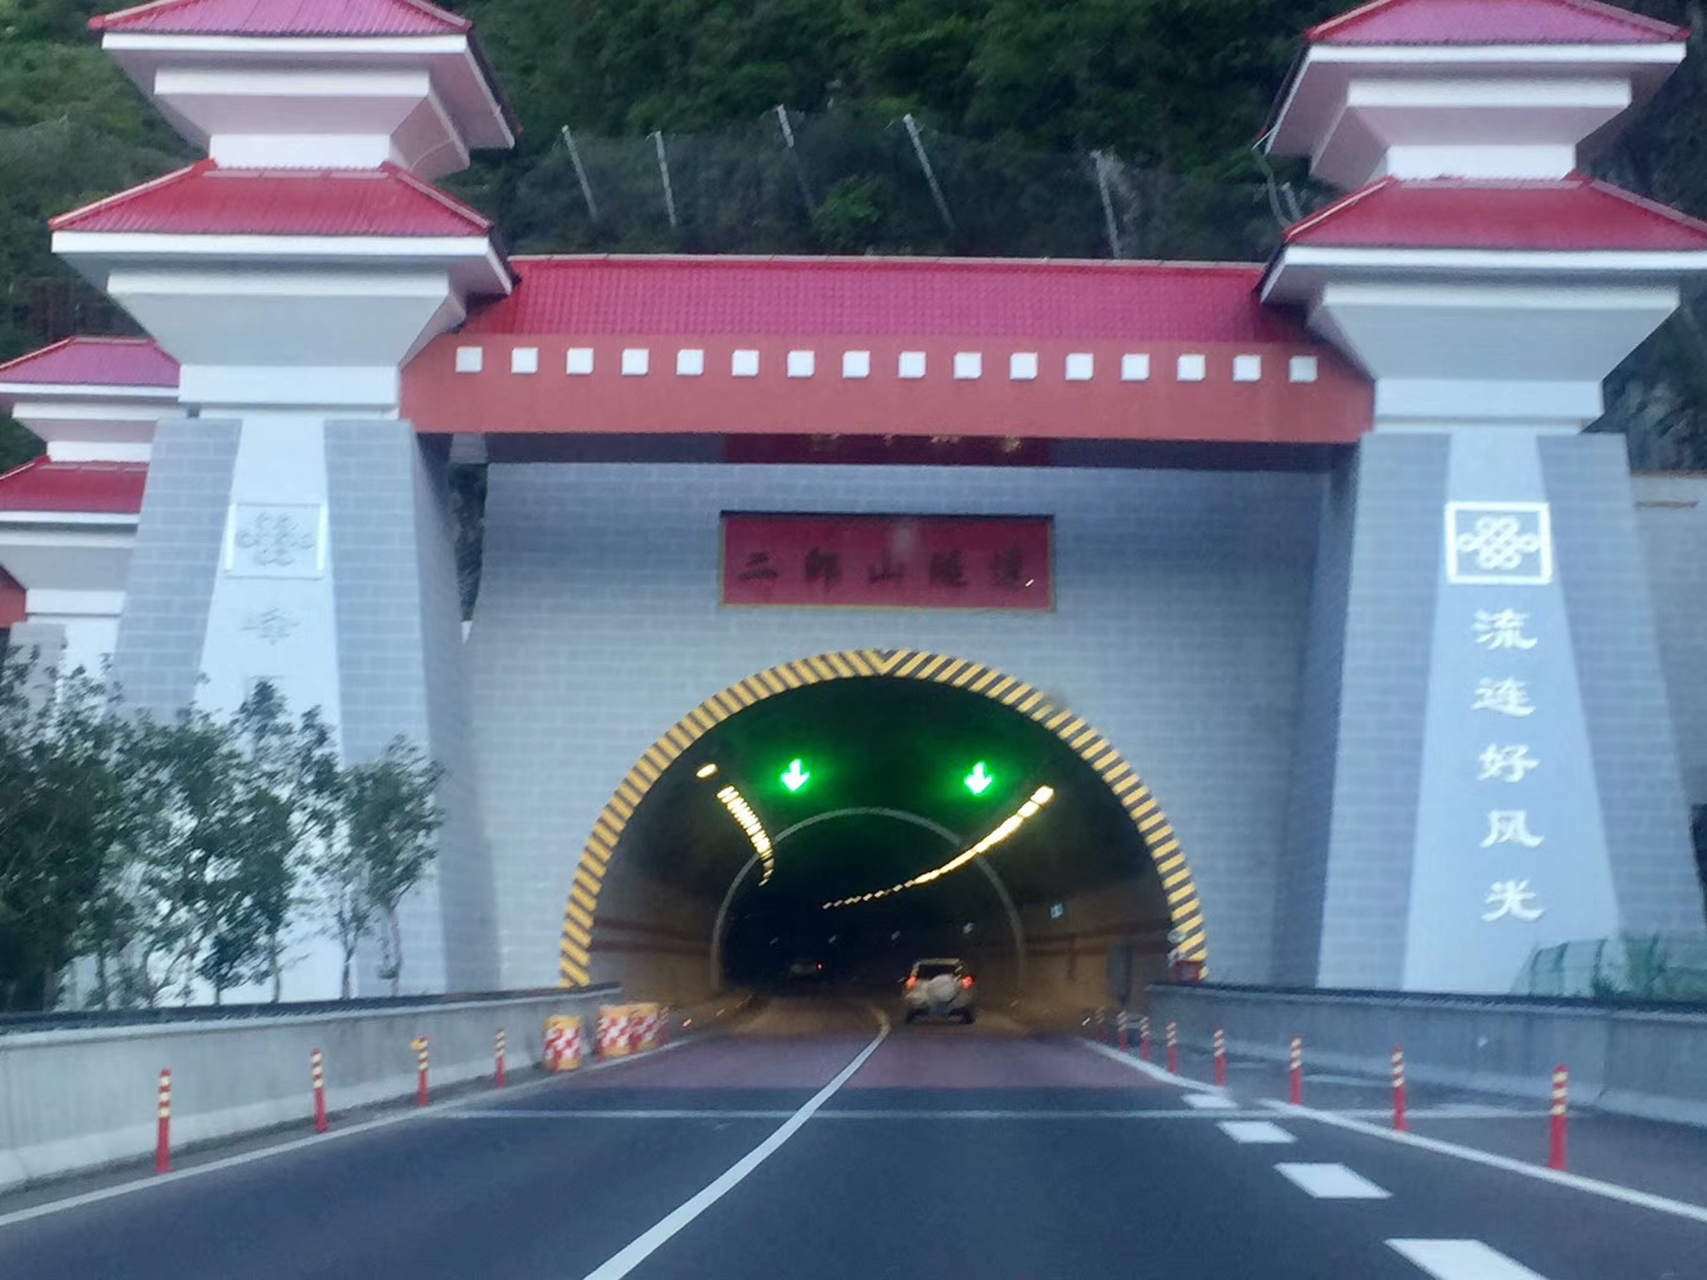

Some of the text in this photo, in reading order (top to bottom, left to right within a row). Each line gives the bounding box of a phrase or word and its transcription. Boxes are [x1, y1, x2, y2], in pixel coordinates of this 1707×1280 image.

[1470, 608, 1545, 922] 流连好风光
